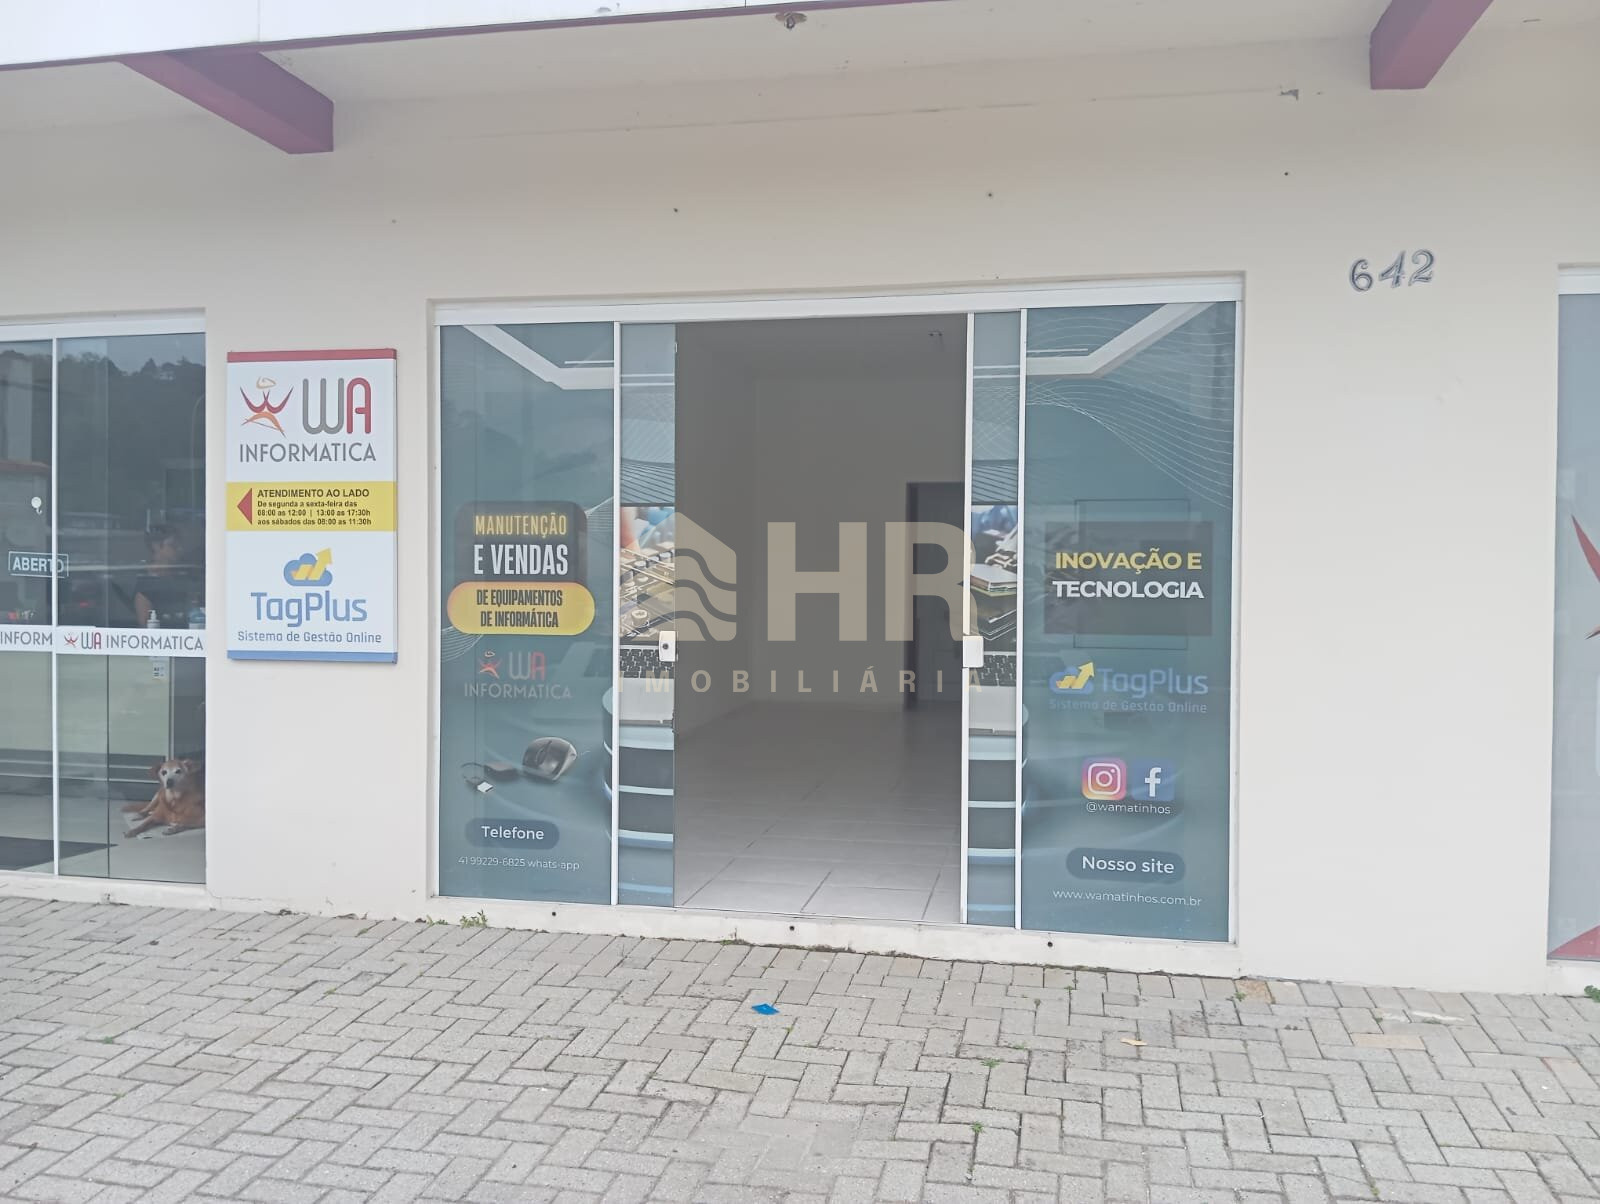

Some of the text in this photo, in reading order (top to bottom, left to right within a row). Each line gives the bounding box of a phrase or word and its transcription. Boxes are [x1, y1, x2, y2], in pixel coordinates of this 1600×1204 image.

[1350, 249, 1434, 292] 642
[302, 377, 372, 435] WA
[239, 442, 376, 463] INFORMATICA
[257, 489, 370, 498] ATENDIMENTO AO LADO
[268, 501, 298, 509] segunda
[475, 513, 567, 538] MANUTENÇÃO
[474, 544, 569, 576] E VENDAS
[1056, 548, 1202, 574] INOVAÇÃO E
[1052, 580, 1204, 598] TECNOLOGIA
[476, 590, 563, 608] DE EQUIPAMENTOS
[250, 590, 368, 627] TagPlus
[480, 608, 559, 628] DE INFORMÁTICA
[81, 632, 204, 650] WA INFORMATICA
[238, 630, 382, 643] Sistema de Gestão Online
[509, 652, 546, 680] WA
[464, 684, 572, 699] INFORMATICA
[1097, 668, 1208, 698] TagPlus
[1104, 700, 1118, 711] de
[1168, 702, 1207, 714] Online
[1086, 802, 1170, 814] @wamatinhos
[481, 825, 545, 840] Telefone
[1082, 855, 1175, 874] Nosso site
[1053, 890, 1202, 906] www.wamatinhos.com.br
